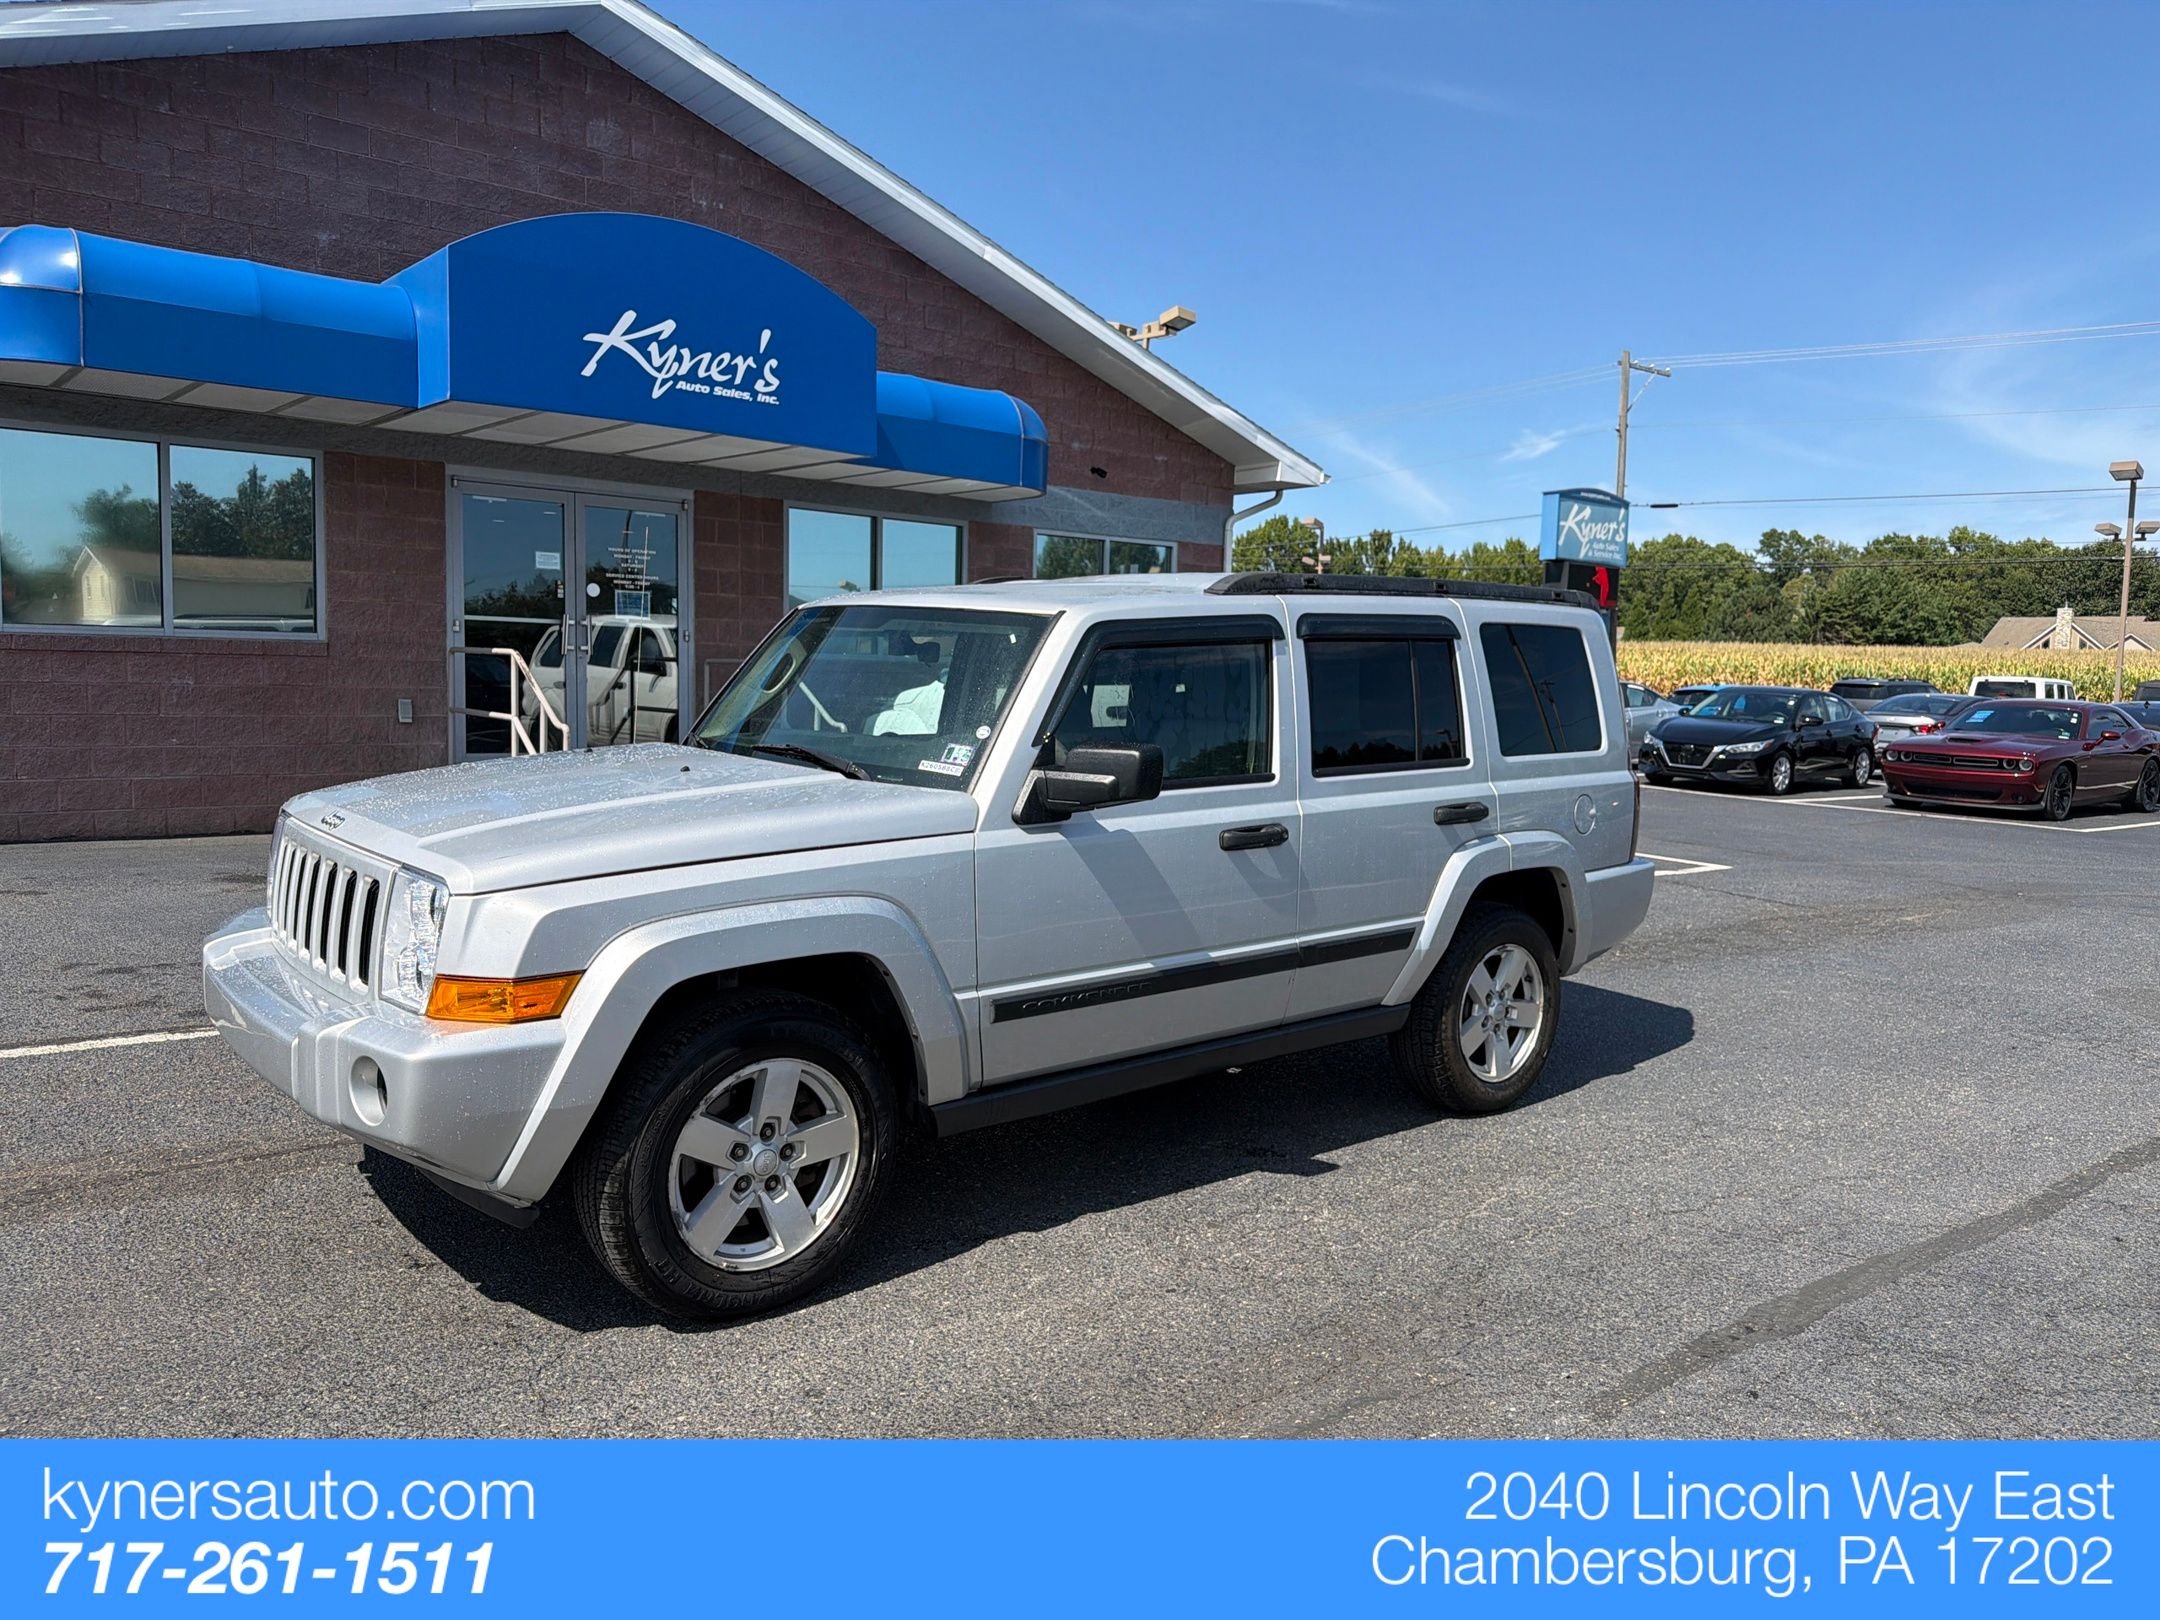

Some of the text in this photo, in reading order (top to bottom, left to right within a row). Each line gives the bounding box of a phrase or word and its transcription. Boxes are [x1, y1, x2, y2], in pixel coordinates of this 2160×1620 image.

[580, 309, 780, 400] Kyner's
[675, 380, 780, 405] Auto Sales, Inc.
[1558, 503, 1626, 560] Kyner's
